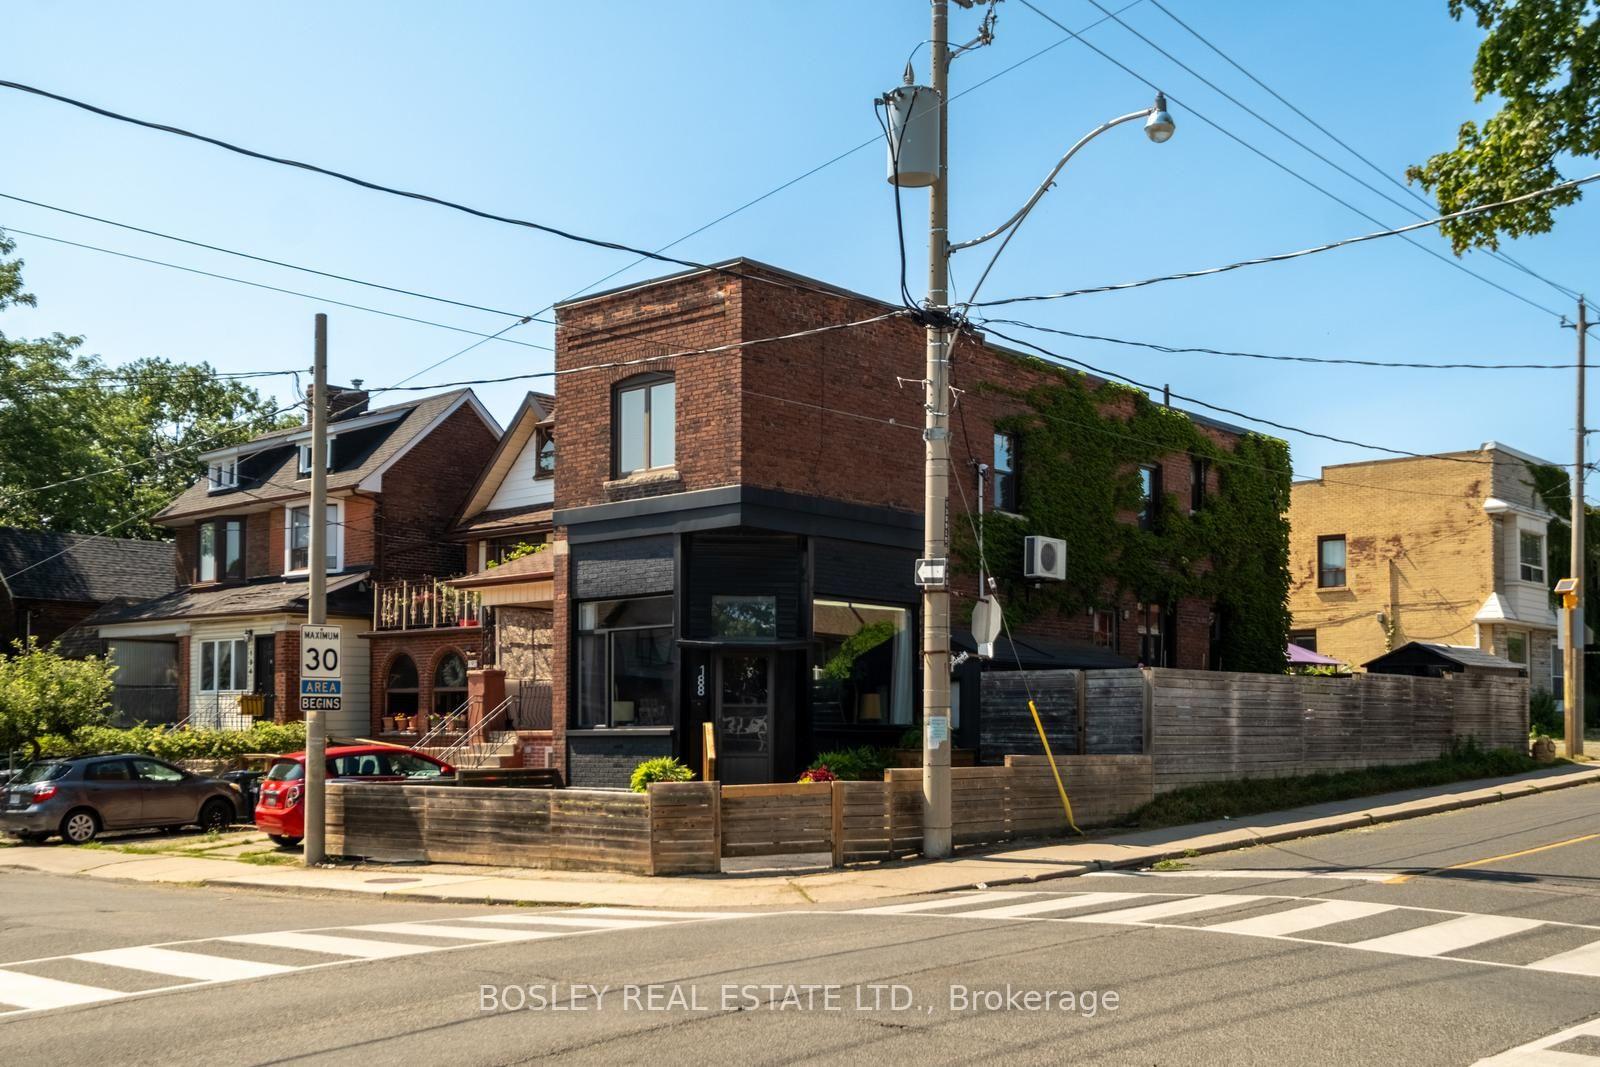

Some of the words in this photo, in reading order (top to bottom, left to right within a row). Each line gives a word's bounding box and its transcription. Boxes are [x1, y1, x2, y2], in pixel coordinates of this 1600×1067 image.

[304, 631, 339, 640] MAXIMUM
[305, 648, 338, 671] 30
[697, 665, 705, 696] 188
[306, 682, 337, 693] AREA
[302, 698, 340, 709] BEGINS
